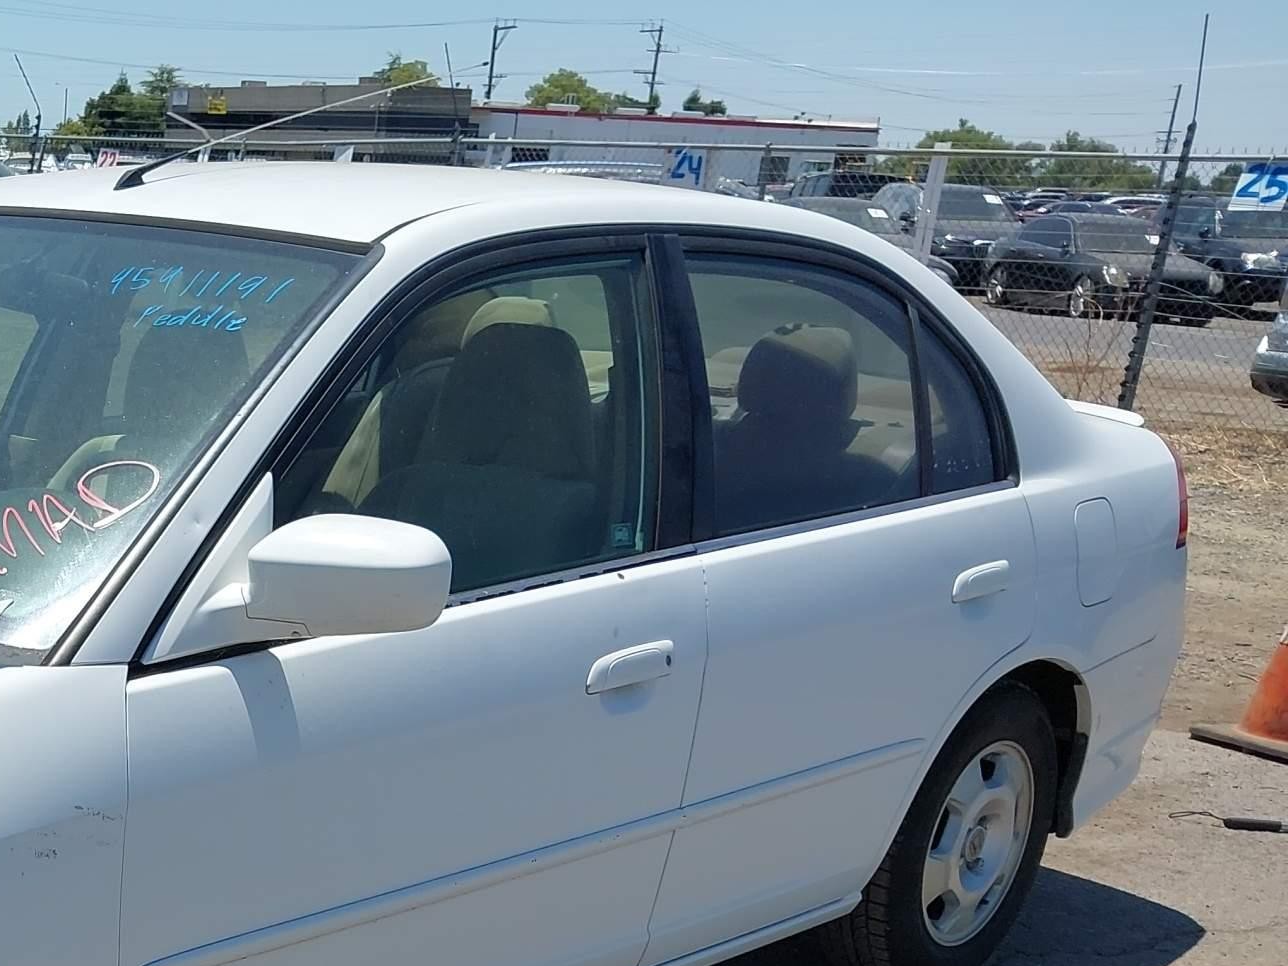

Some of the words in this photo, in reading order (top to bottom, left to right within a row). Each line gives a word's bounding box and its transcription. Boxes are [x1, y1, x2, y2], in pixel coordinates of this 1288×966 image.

[98, 150, 117, 167] 22
[671, 149, 703, 186] 24
[1235, 162, 1288, 203] 25
[111, 266, 296, 303] 45411191
